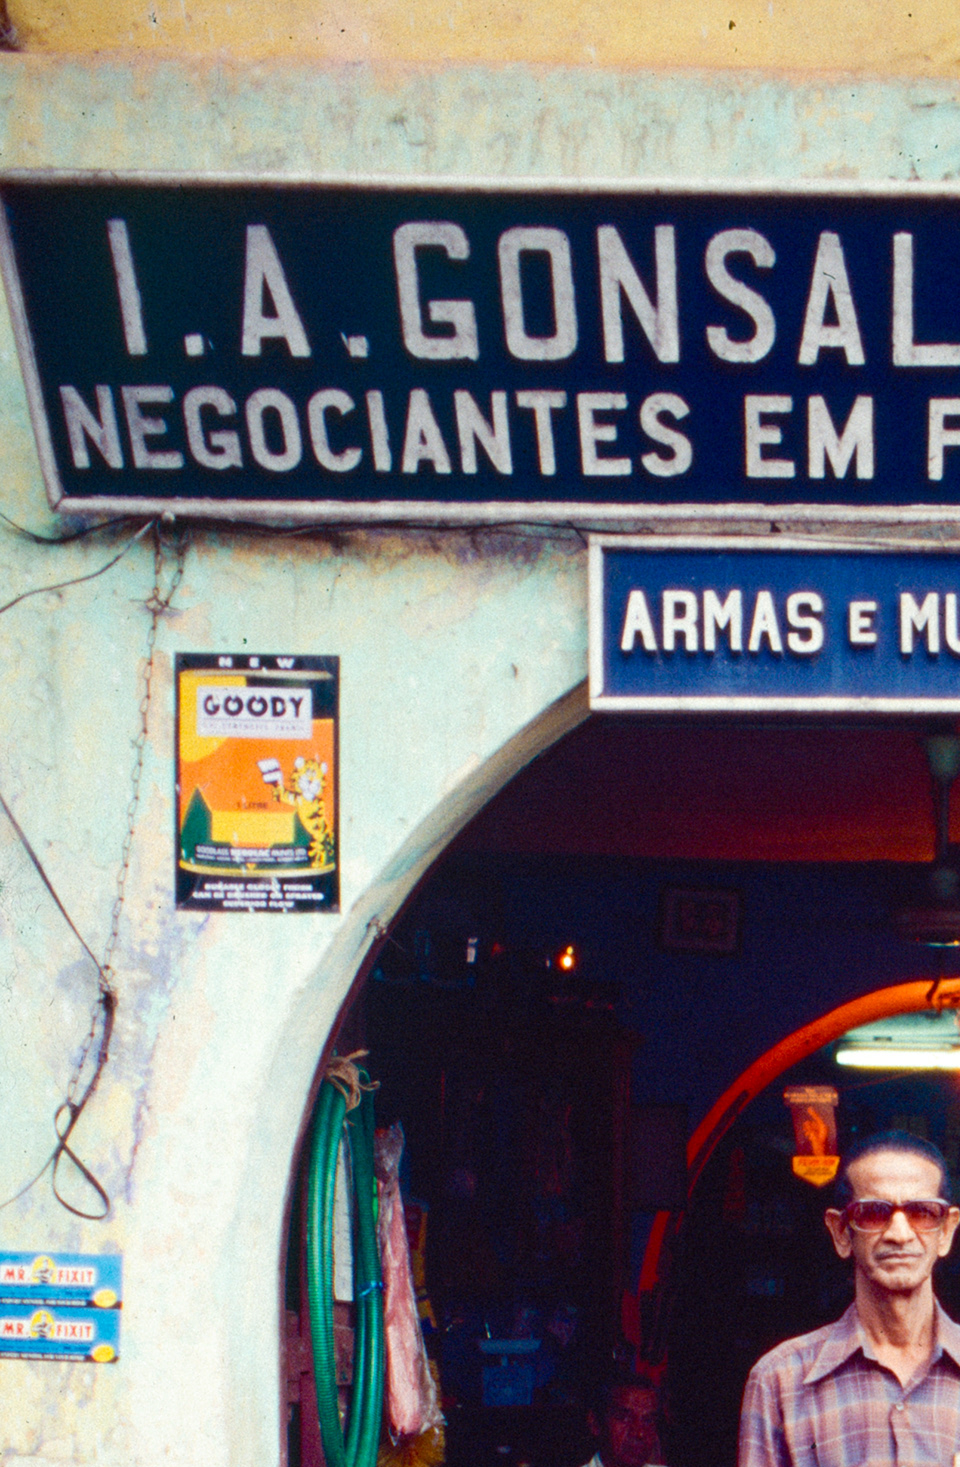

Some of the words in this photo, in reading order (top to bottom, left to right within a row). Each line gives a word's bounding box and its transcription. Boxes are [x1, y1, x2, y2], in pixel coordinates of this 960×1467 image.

[59, 386, 692, 477] NEGOCIANTES
[744, 395, 874, 479] EM
[620, 589, 824, 653] ARMAS
[849, 600, 877, 643] E
[203, 694, 304, 718] GOODY
[58, 1270, 94, 1283] FIXIT
[56, 1325, 92, 1338] FIXIT
